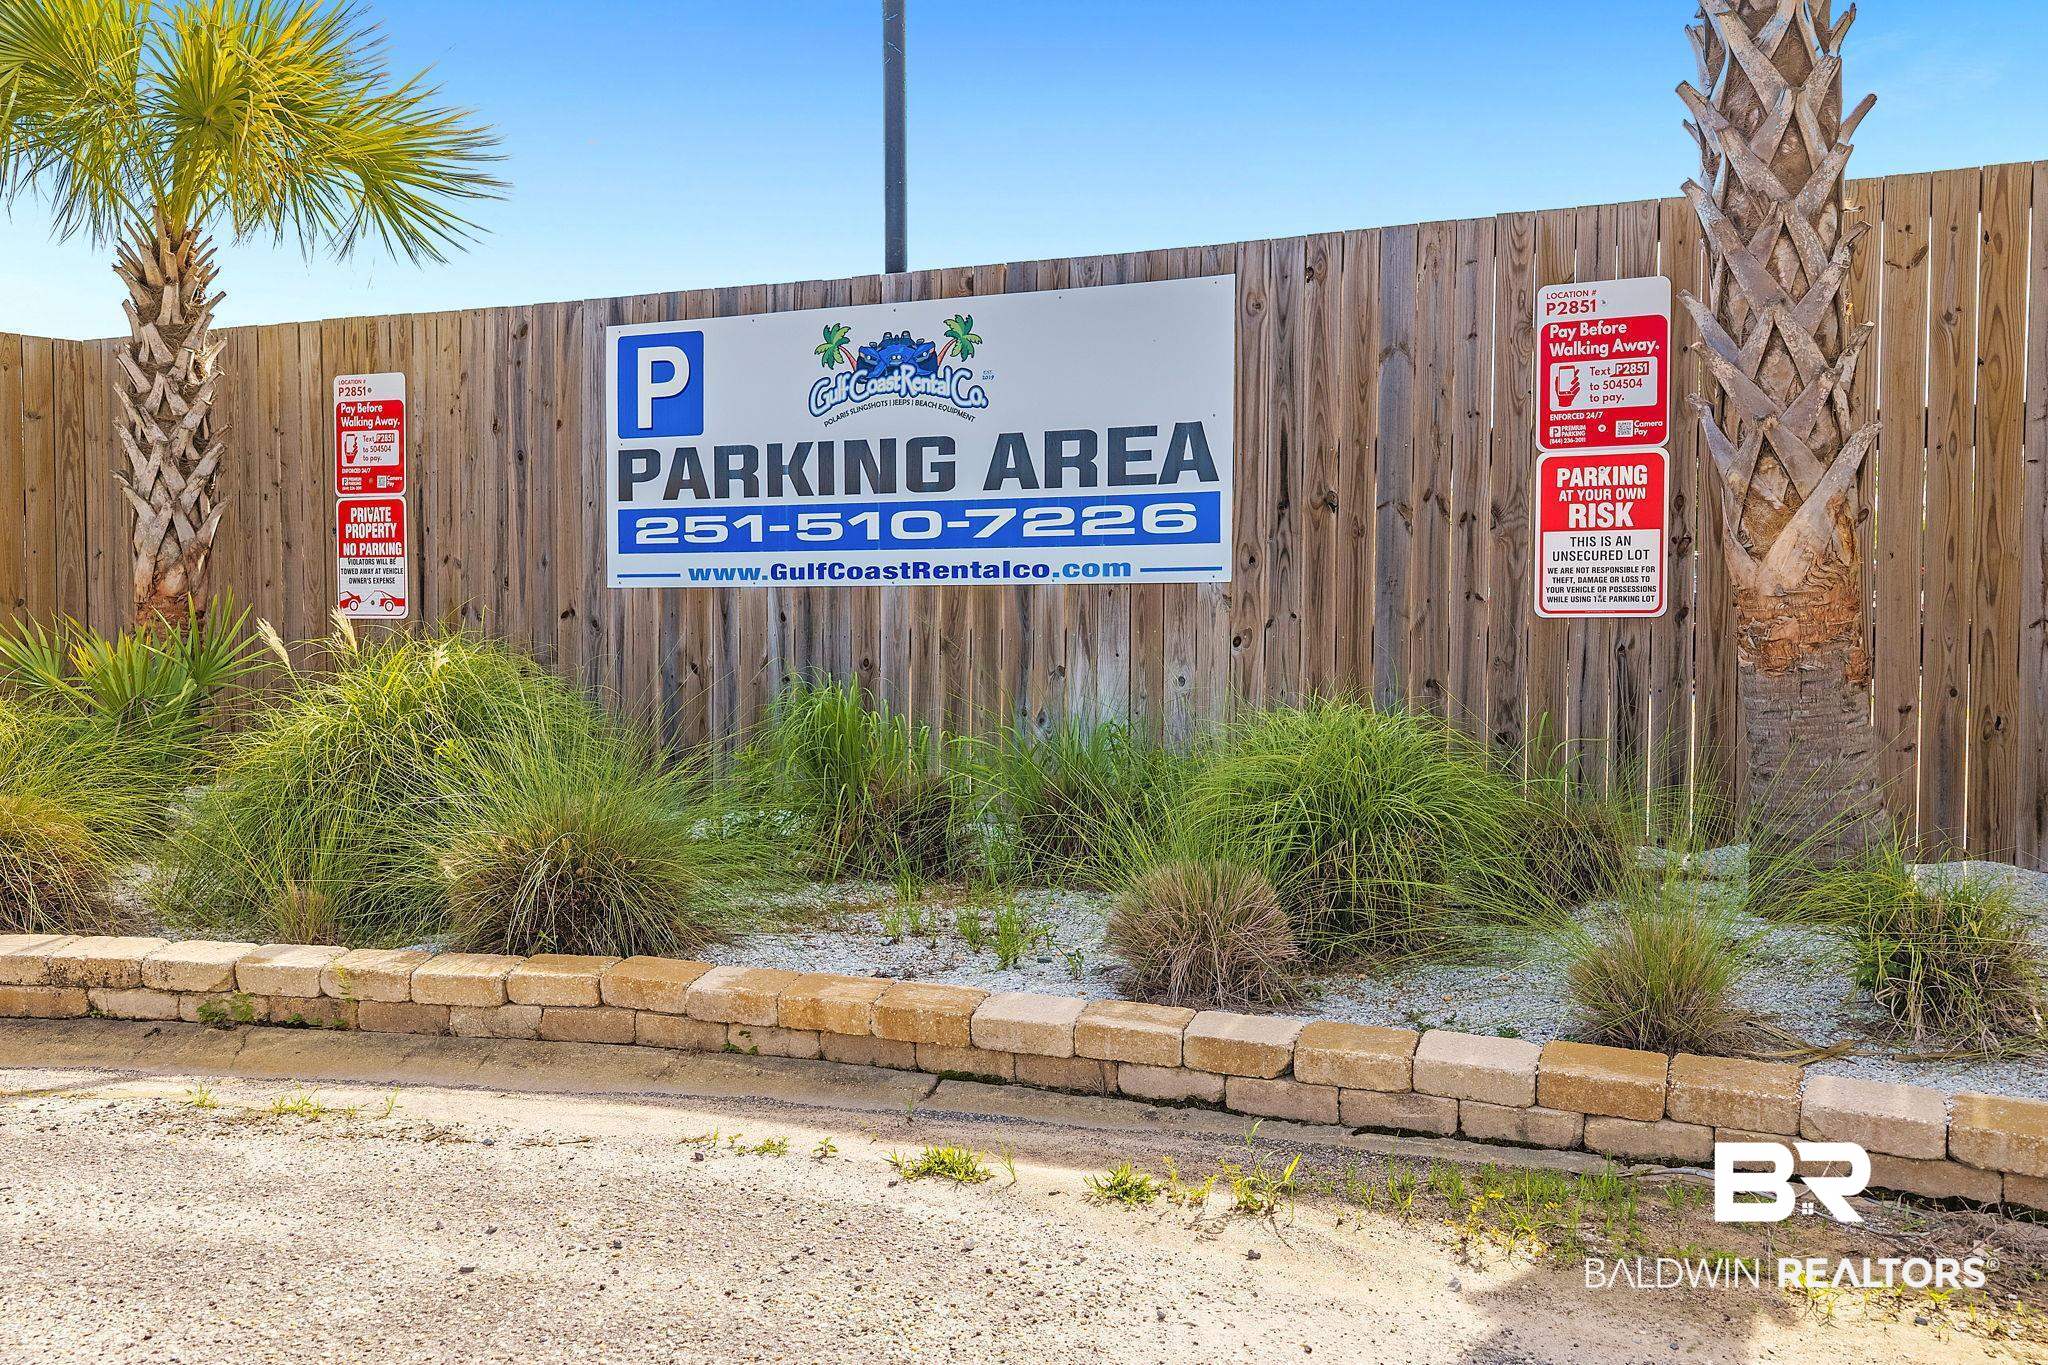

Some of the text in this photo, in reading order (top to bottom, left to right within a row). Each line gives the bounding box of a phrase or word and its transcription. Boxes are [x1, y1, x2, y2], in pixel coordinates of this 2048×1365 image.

[1547, 290, 1589, 299] LOCATION
[1546, 299, 1596, 316] P2851
[1550, 320, 1627, 341] Pay Before
[1550, 339, 1659, 358] Walking Away.
[1590, 362, 1648, 376] Text P2851
[637, 345, 690, 430] P
[809, 363, 989, 417] Gulf Coast Rental Co.
[1590, 378, 1642, 391] to 504504
[339, 387, 366, 397] P2851
[1590, 393, 1624, 403] to pay.
[341, 403, 383, 415] Pay Before
[823, 400, 888, 427] POLARIS SLINGSHOTS
[915, 400, 976, 422] BEACH EQUIPMENT
[341, 416, 400, 429] Walking Away.
[1550, 413, 1584, 421] ENFORCED
[1634, 428, 1647, 436] Pay
[618, 421, 1219, 501] PARKING AREA
[1557, 465, 1648, 487] PARKING
[1559, 488, 1646, 501] AT YOUR OWN
[350, 507, 391, 522] PRIVATE
[1568, 502, 1634, 528] RISK
[634, 502, 1197, 545] 251-510-7226
[346, 523, 397, 539] PROPERTY
[1570, 536, 1632, 547] THIS IS AN
[343, 542, 402, 556] NO PARKING
[1552, 550, 1650, 561] UNSECURED LOT
[688, 559, 1132, 583] www.GulfCoastRentalco.com
[1591, 566, 1639, 574] RESPONSIBLE
